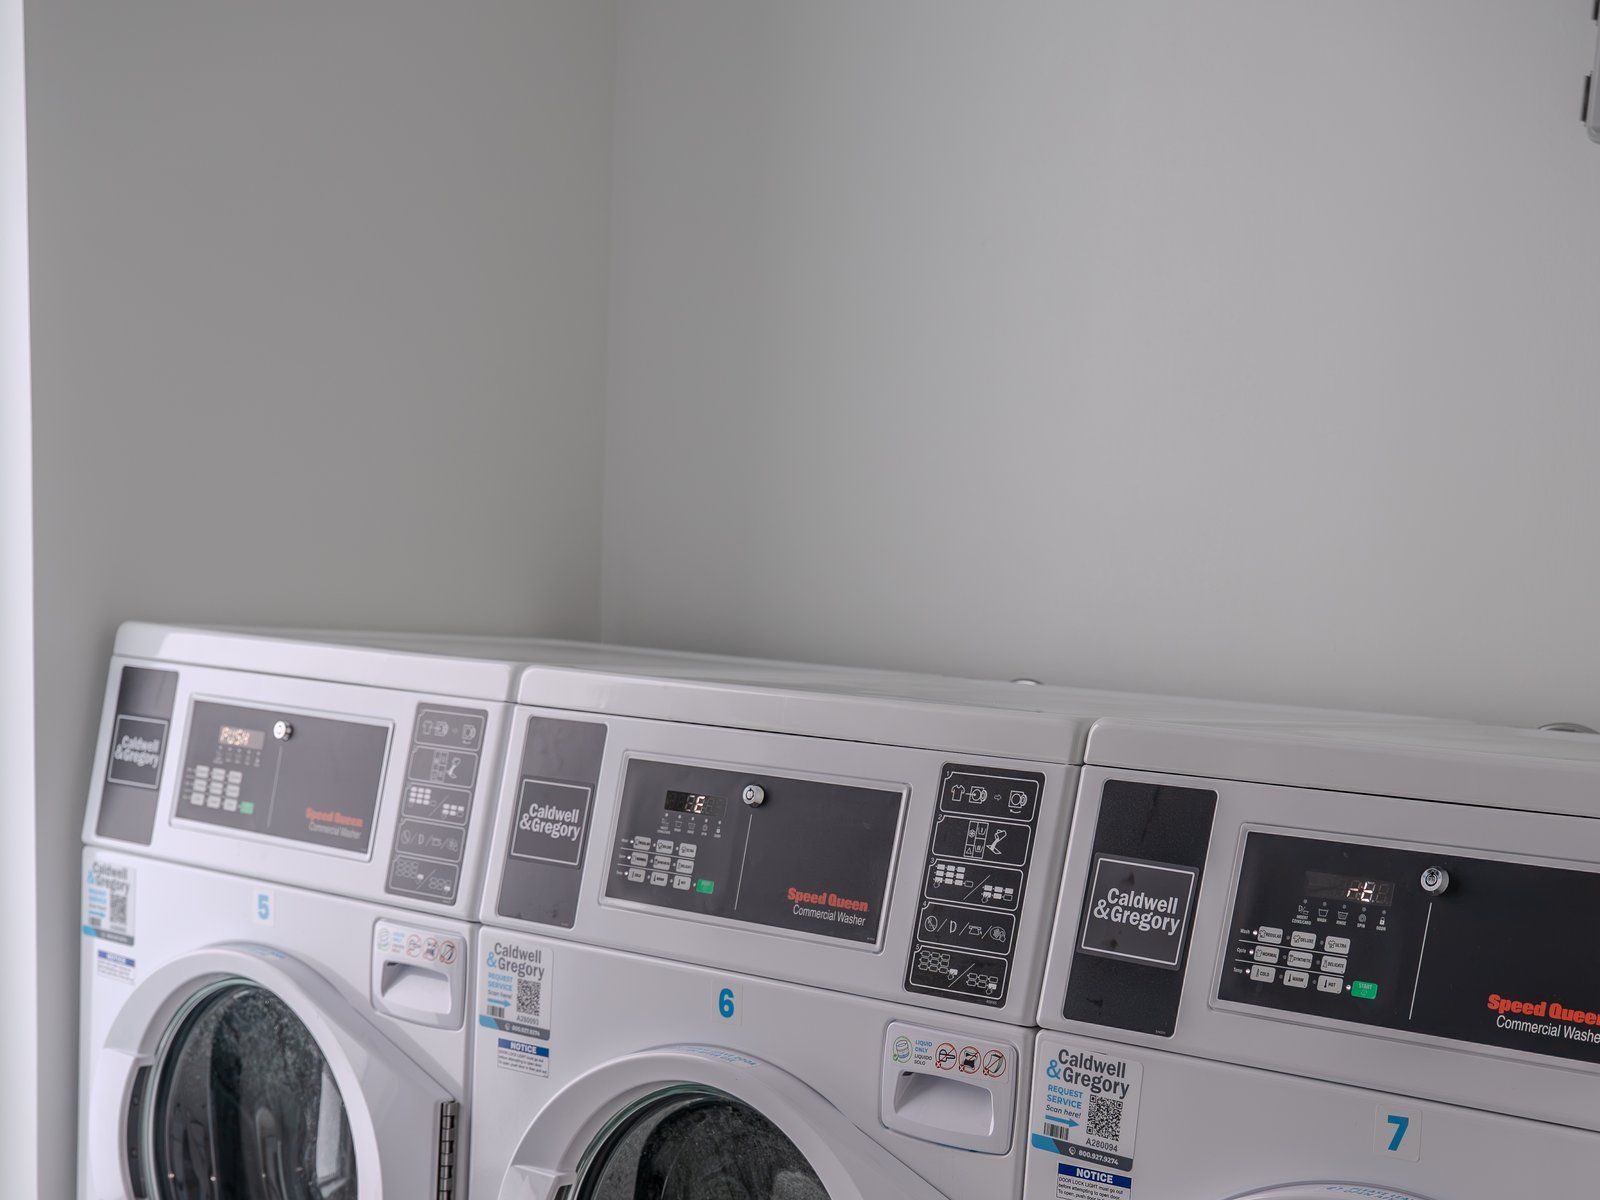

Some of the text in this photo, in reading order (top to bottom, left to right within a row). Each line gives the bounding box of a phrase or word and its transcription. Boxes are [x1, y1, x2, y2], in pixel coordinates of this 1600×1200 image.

[122, 735, 160, 753] Caldwell
[114, 744, 159, 769] &Gregory
[529, 803, 579, 823] Caldwell
[520, 813, 581, 841] &Gregory
[93, 861, 128, 880] Caldwell
[258, 894, 270, 920] 5
[787, 887, 869, 912] Speed Queen
[1107, 887, 1179, 915] Caldwell
[793, 904, 866, 926] Commercial Washer
[1093, 899, 1180, 936] &Gregory
[494, 942, 542, 964] Caldwell
[488, 981, 513, 992] SERVICE
[719, 988, 734, 1018] 6
[1487, 993, 1547, 1017] Speed
[1496, 1015, 1561, 1037] Commercial
[510, 1042, 537, 1054] NOTICE
[1058, 1049, 1126, 1078] Caldwell
[1047, 1095, 1082, 1109] SERVICE
[1048, 1084, 1083, 1098] REQUEST
[1046, 1105, 1081, 1118] Scan here!
[1388, 1115, 1409, 1151] 7
[1086, 1138, 1118, 1152] A280094
[1078, 1150, 1119, 1165] 800.927.9274
[1076, 1168, 1113, 1184] NOTICE
